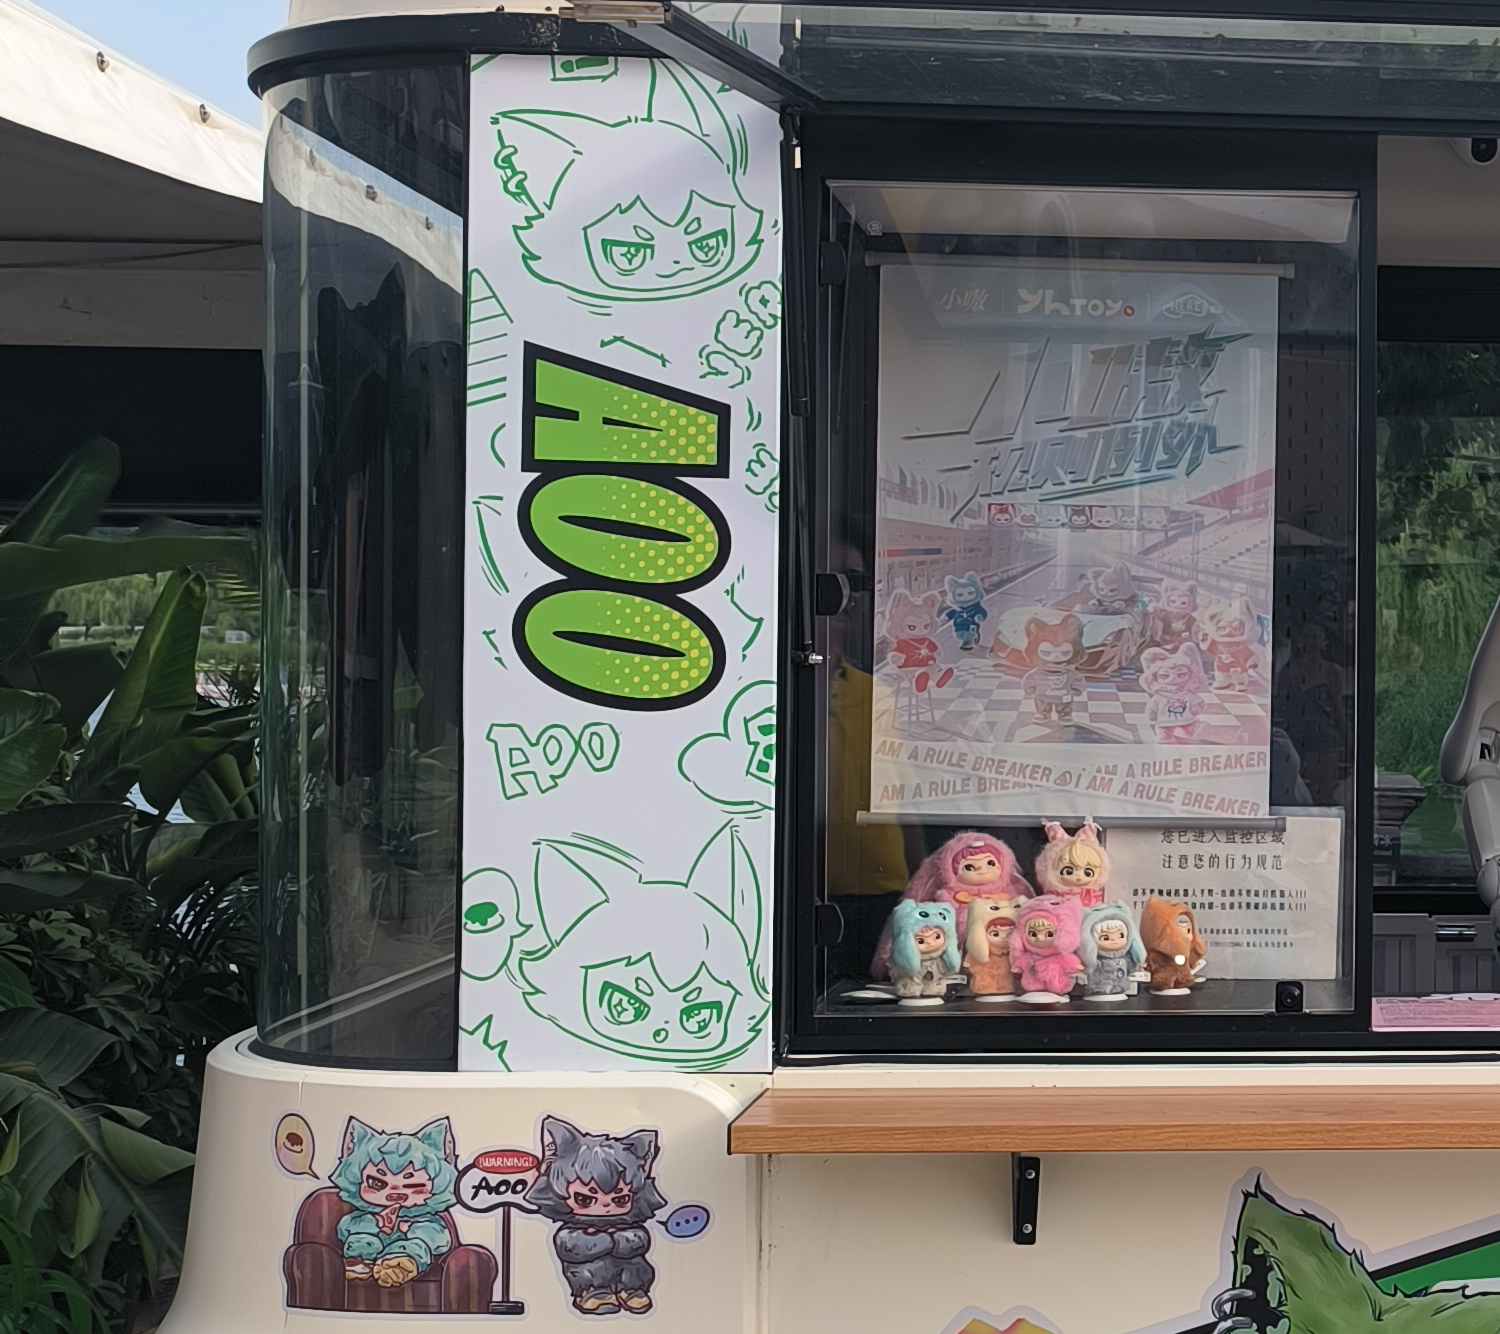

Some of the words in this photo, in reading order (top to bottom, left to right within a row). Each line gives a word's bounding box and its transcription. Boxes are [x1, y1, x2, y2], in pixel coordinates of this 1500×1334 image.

[512, 341, 731, 710] AOO
[1126, 762, 1135, 778] A
[1141, 758, 1182, 778] RULE
[1189, 751, 1267, 774] BREAKER
[875, 740, 902, 759] AM
[908, 746, 919, 762] A
[923, 748, 967, 769] RULE
[972, 756, 1052, 783] BREAKER
[1086, 775, 1112, 794] AM
[1118, 782, 1130, 797] A
[1134, 782, 1176, 804] RULE
[1181, 792, 1261, 816] BREAKER
[879, 784, 905, 803] AM
[912, 782, 924, 800] A
[928, 777, 970, 798] RULE
[1161, 829, 1285, 846] 您已进入监控区域
[1162, 854, 1283, 871] 注意您的行为规范
